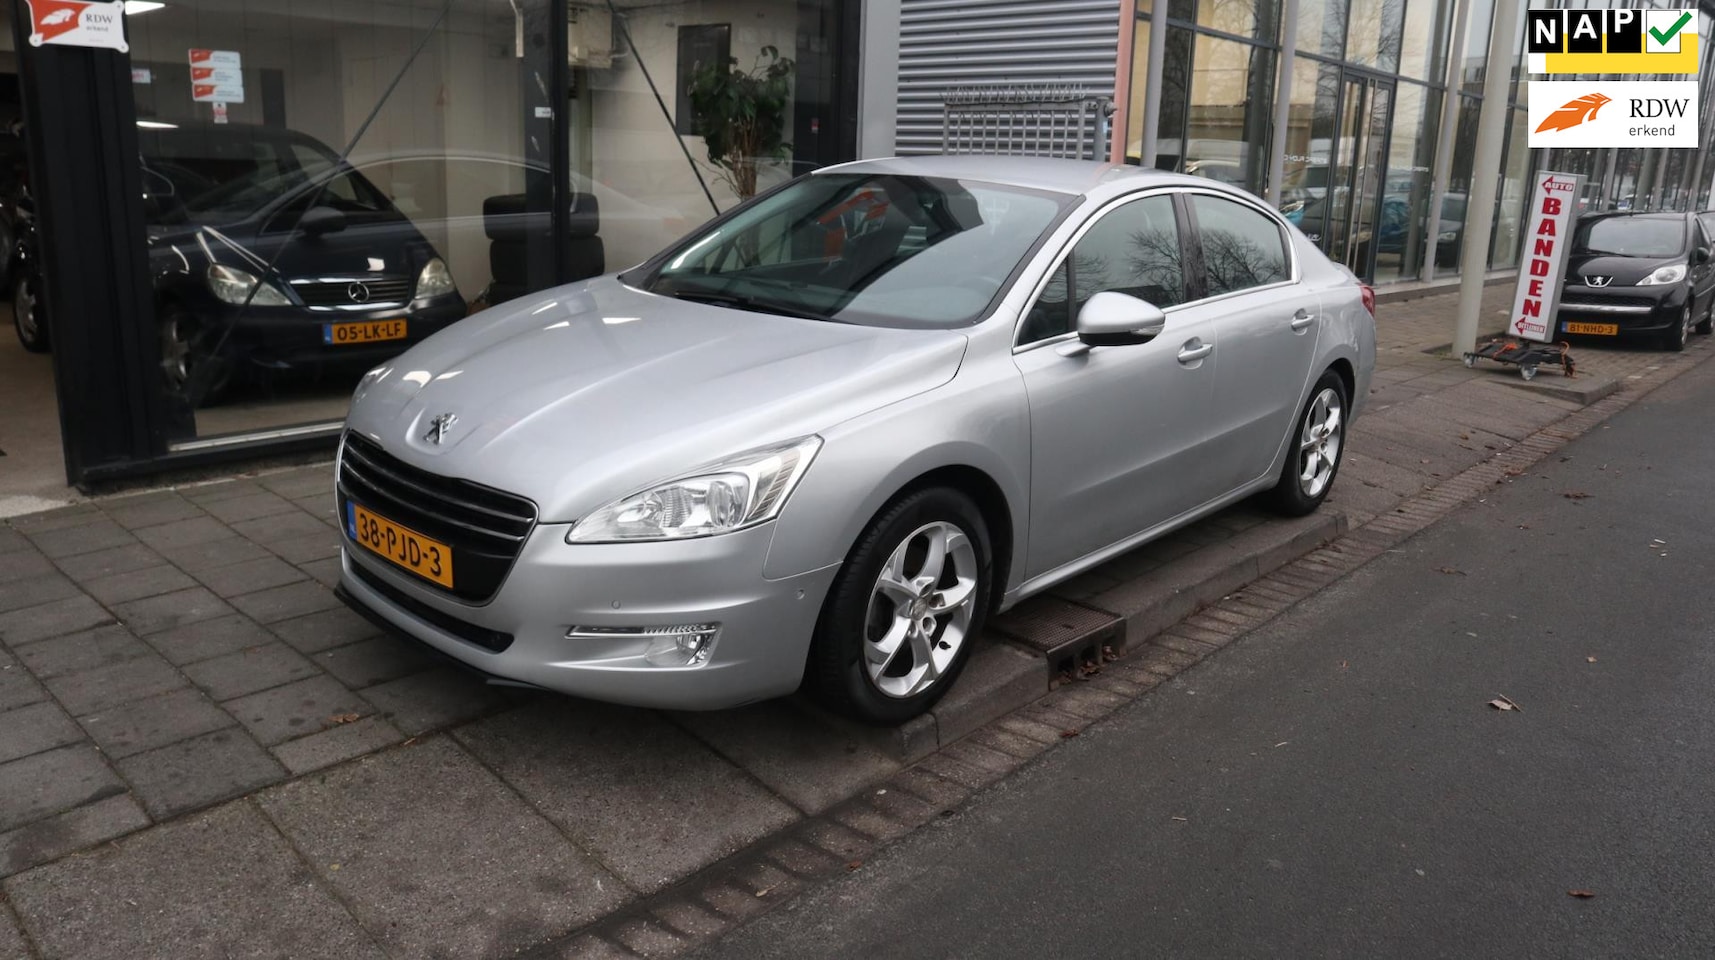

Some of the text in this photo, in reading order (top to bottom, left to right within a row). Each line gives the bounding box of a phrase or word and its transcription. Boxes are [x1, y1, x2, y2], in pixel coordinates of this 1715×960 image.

[86, 14, 113, 23] RDW
[1544, 181, 1573, 191] AUTO
[1522, 197, 1562, 317] BANDEN
[337, 323, 401, 341] 05-LK-LF
[1570, 324, 1614, 334] 81-NHD-3
[360, 513, 442, 576] 38-PJD-3
